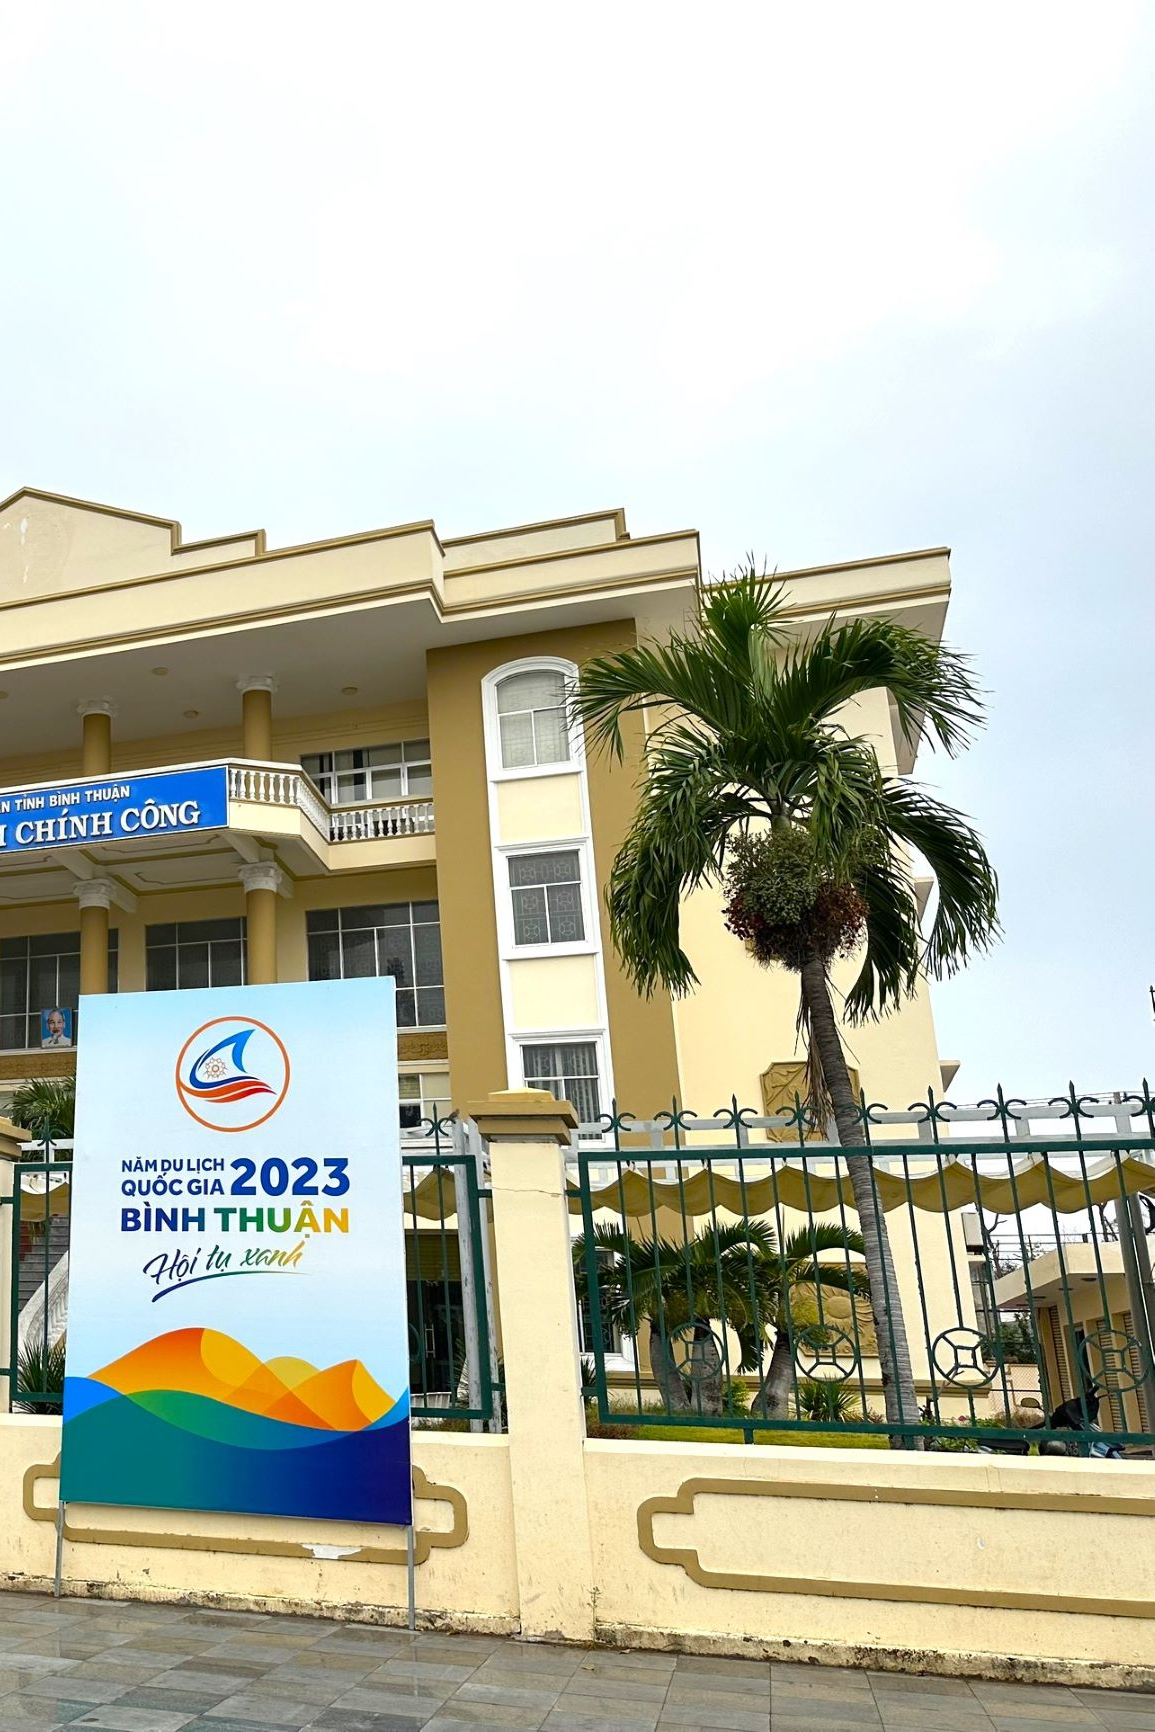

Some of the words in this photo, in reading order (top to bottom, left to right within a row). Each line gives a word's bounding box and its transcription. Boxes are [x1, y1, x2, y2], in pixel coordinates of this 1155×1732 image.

[15, 793, 45, 811] TỈNH
[49, 791, 80, 807] BÌNH
[85, 784, 131, 803] THUẬN
[15, 808, 113, 844] CHÍNH
[120, 798, 201, 832] CÔNG
[121, 1156, 158, 1173] NĂM
[161, 1158, 183, 1172] DU
[186, 1158, 225, 1174] LỊCH
[121, 1172, 184, 1197] QUỐC
[187, 1178, 225, 1196] GIA
[229, 1156, 351, 1197] 2023
[121, 1201, 206, 1232] BÌNH
[213, 1200, 349, 1239] THUẬN
[142, 1247, 202, 1285] Hội
[205, 1244, 233, 1272] tụ
[239, 1240, 305, 1268] xanh
